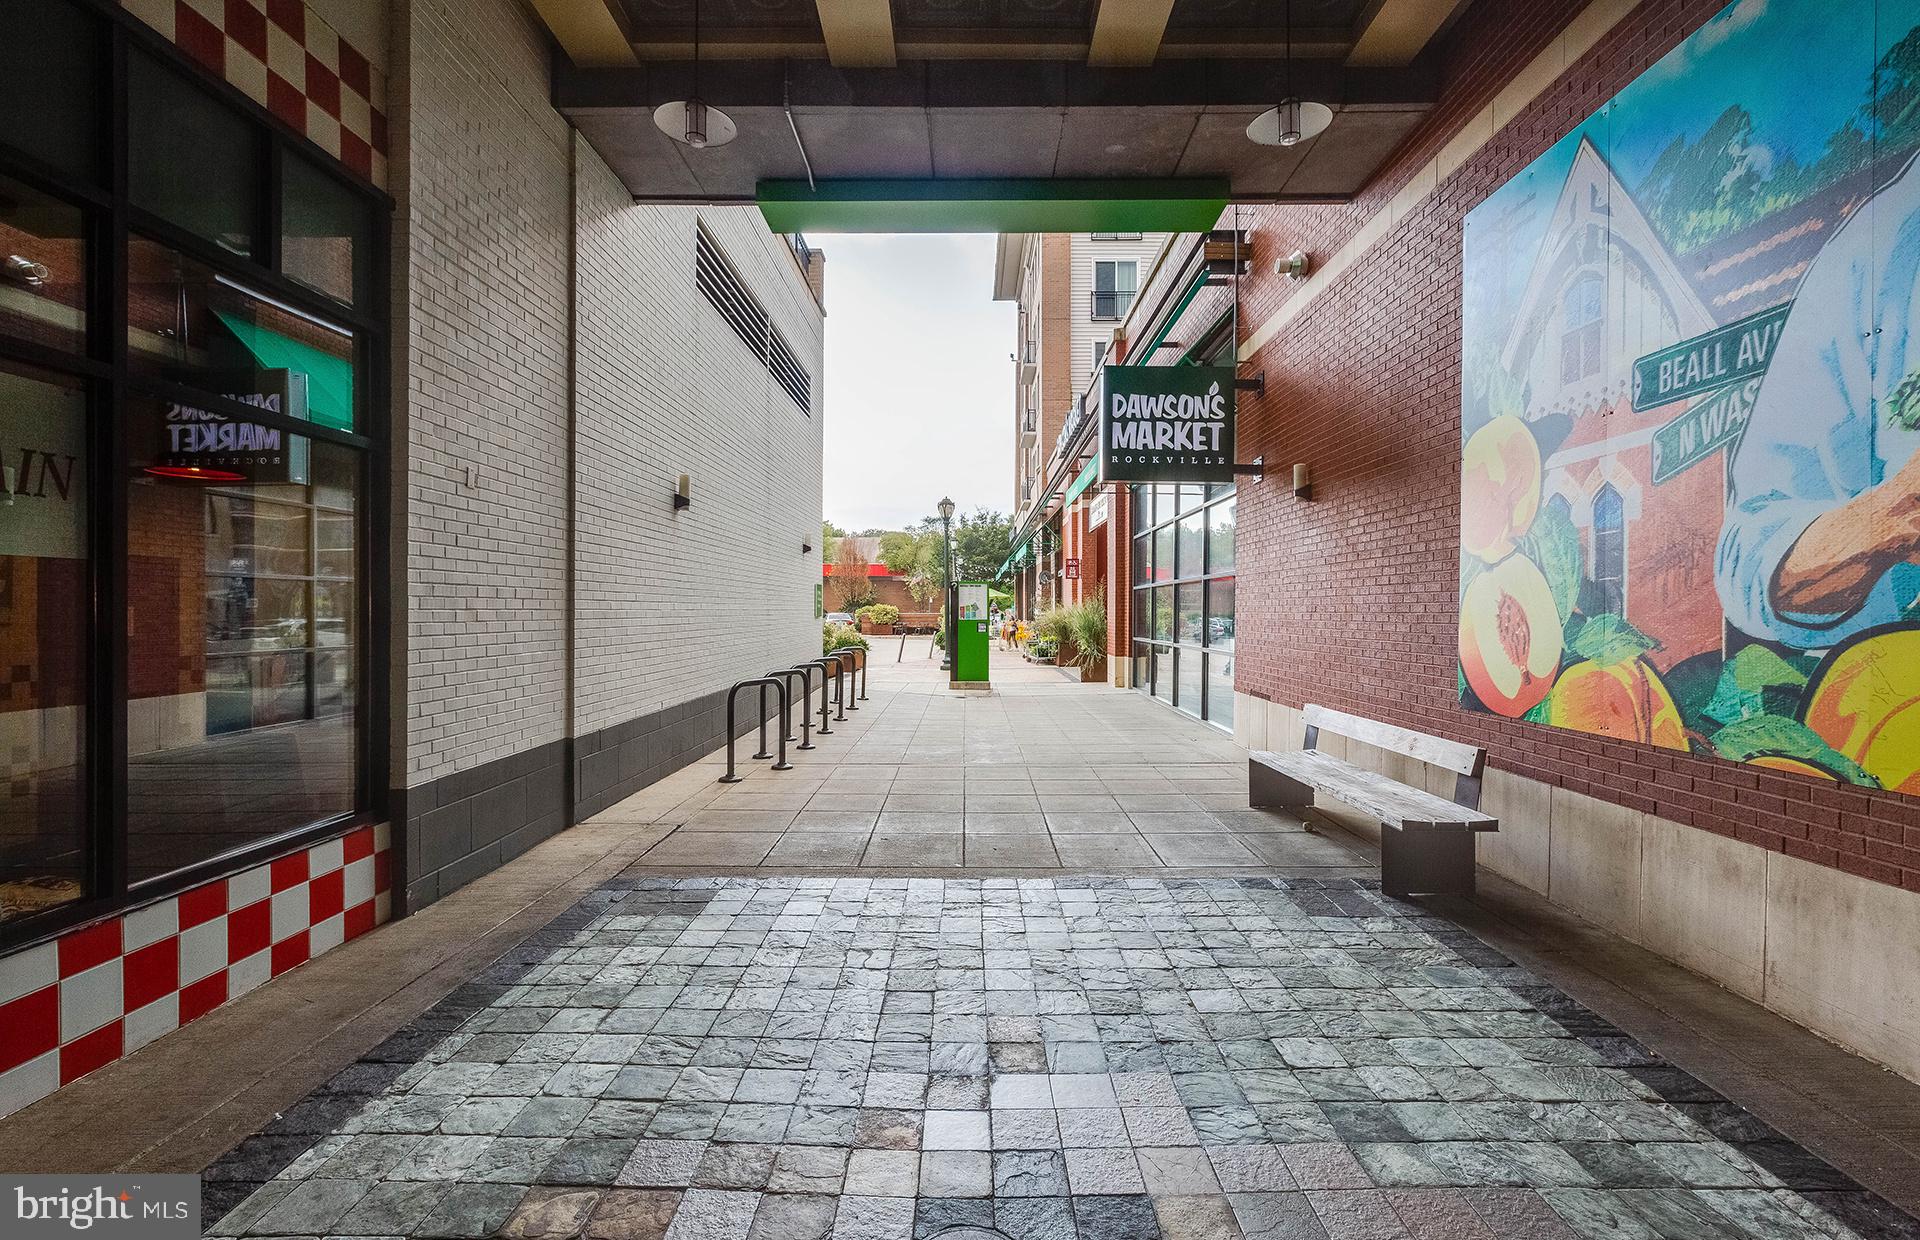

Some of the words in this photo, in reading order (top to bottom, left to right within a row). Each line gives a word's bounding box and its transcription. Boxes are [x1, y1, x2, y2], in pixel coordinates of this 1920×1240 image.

[1658, 341, 1727, 394] BEALL
[1112, 381, 1226, 420] DAWSON'S
[1111, 420, 1226, 451] MARKET
[1679, 418, 1696, 460] N
[0, 447, 77, 501] IN
[1111, 455, 1225, 465] ROCKVILLE
